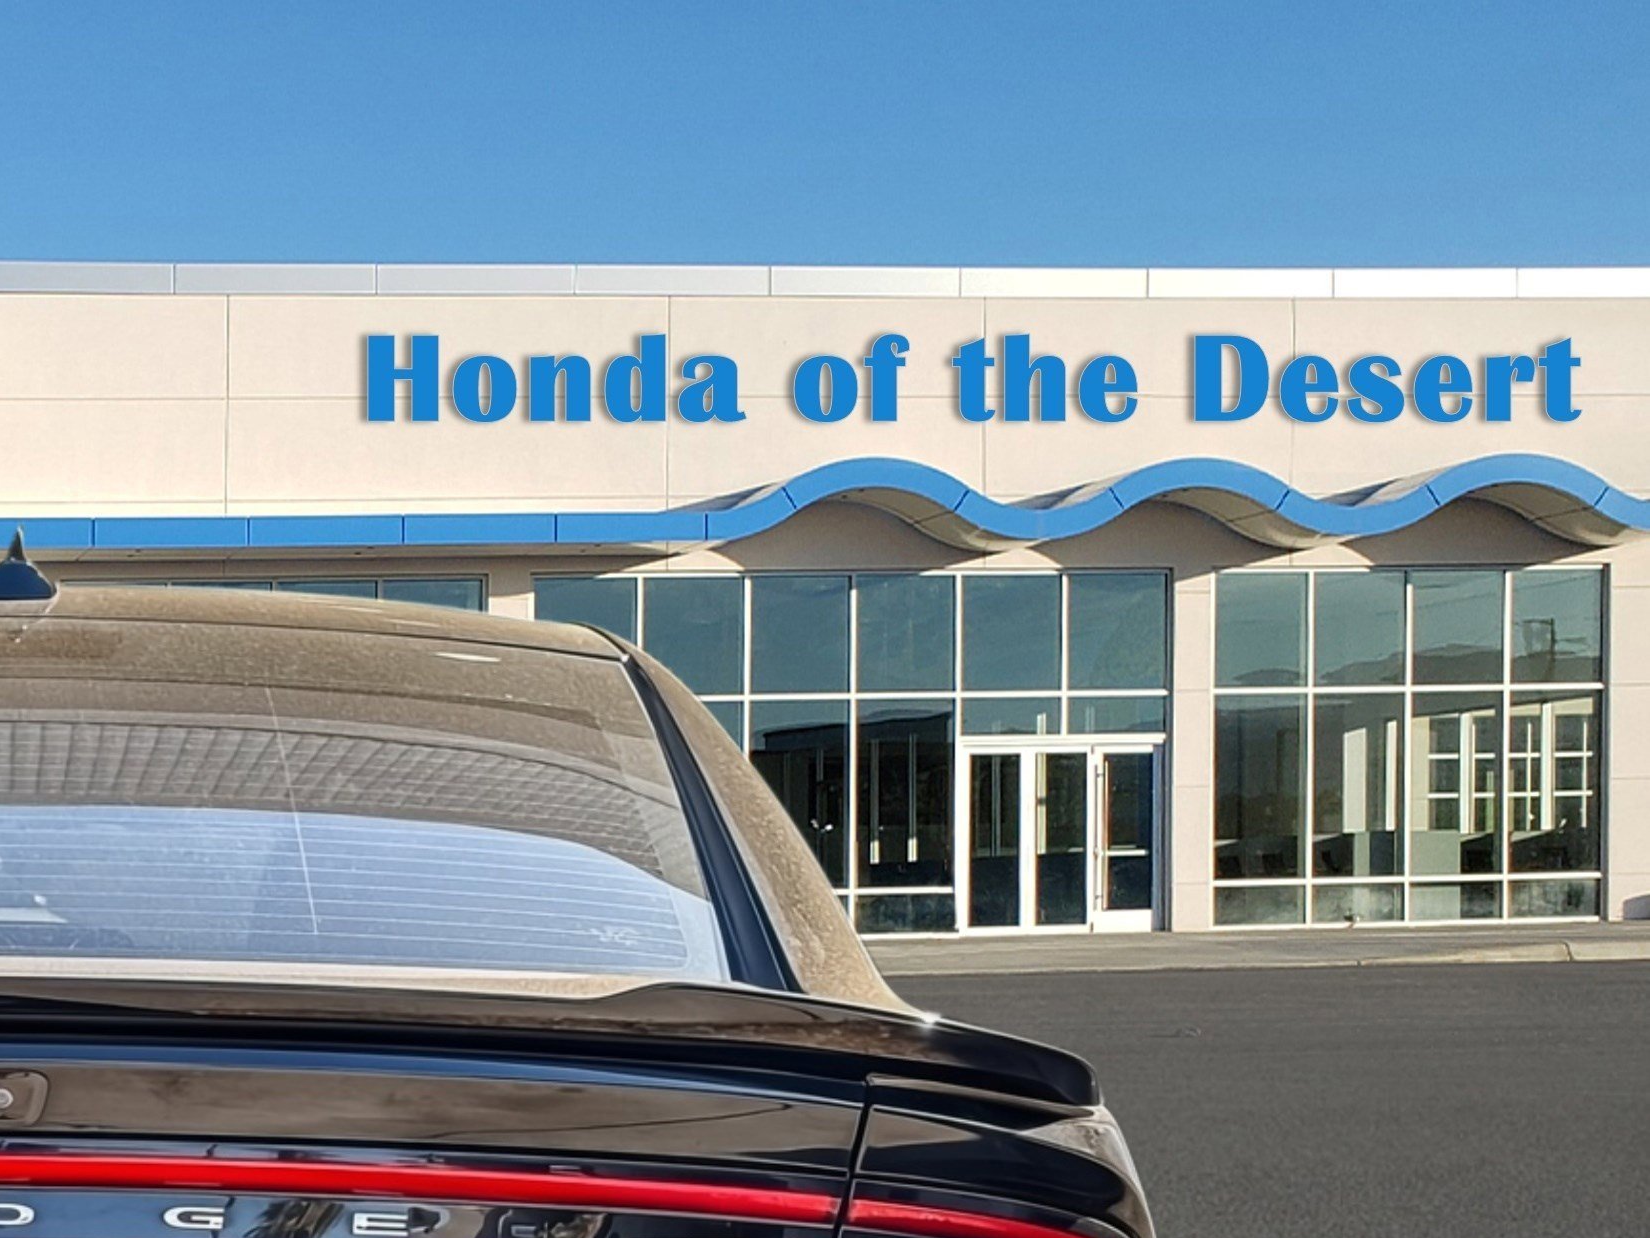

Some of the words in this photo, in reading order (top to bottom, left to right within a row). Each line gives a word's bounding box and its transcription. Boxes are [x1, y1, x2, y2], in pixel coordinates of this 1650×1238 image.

[364, 332, 747, 424] Honda
[793, 332, 911, 424] of
[951, 332, 1139, 424] the
[1193, 333, 1583, 424] Desert
